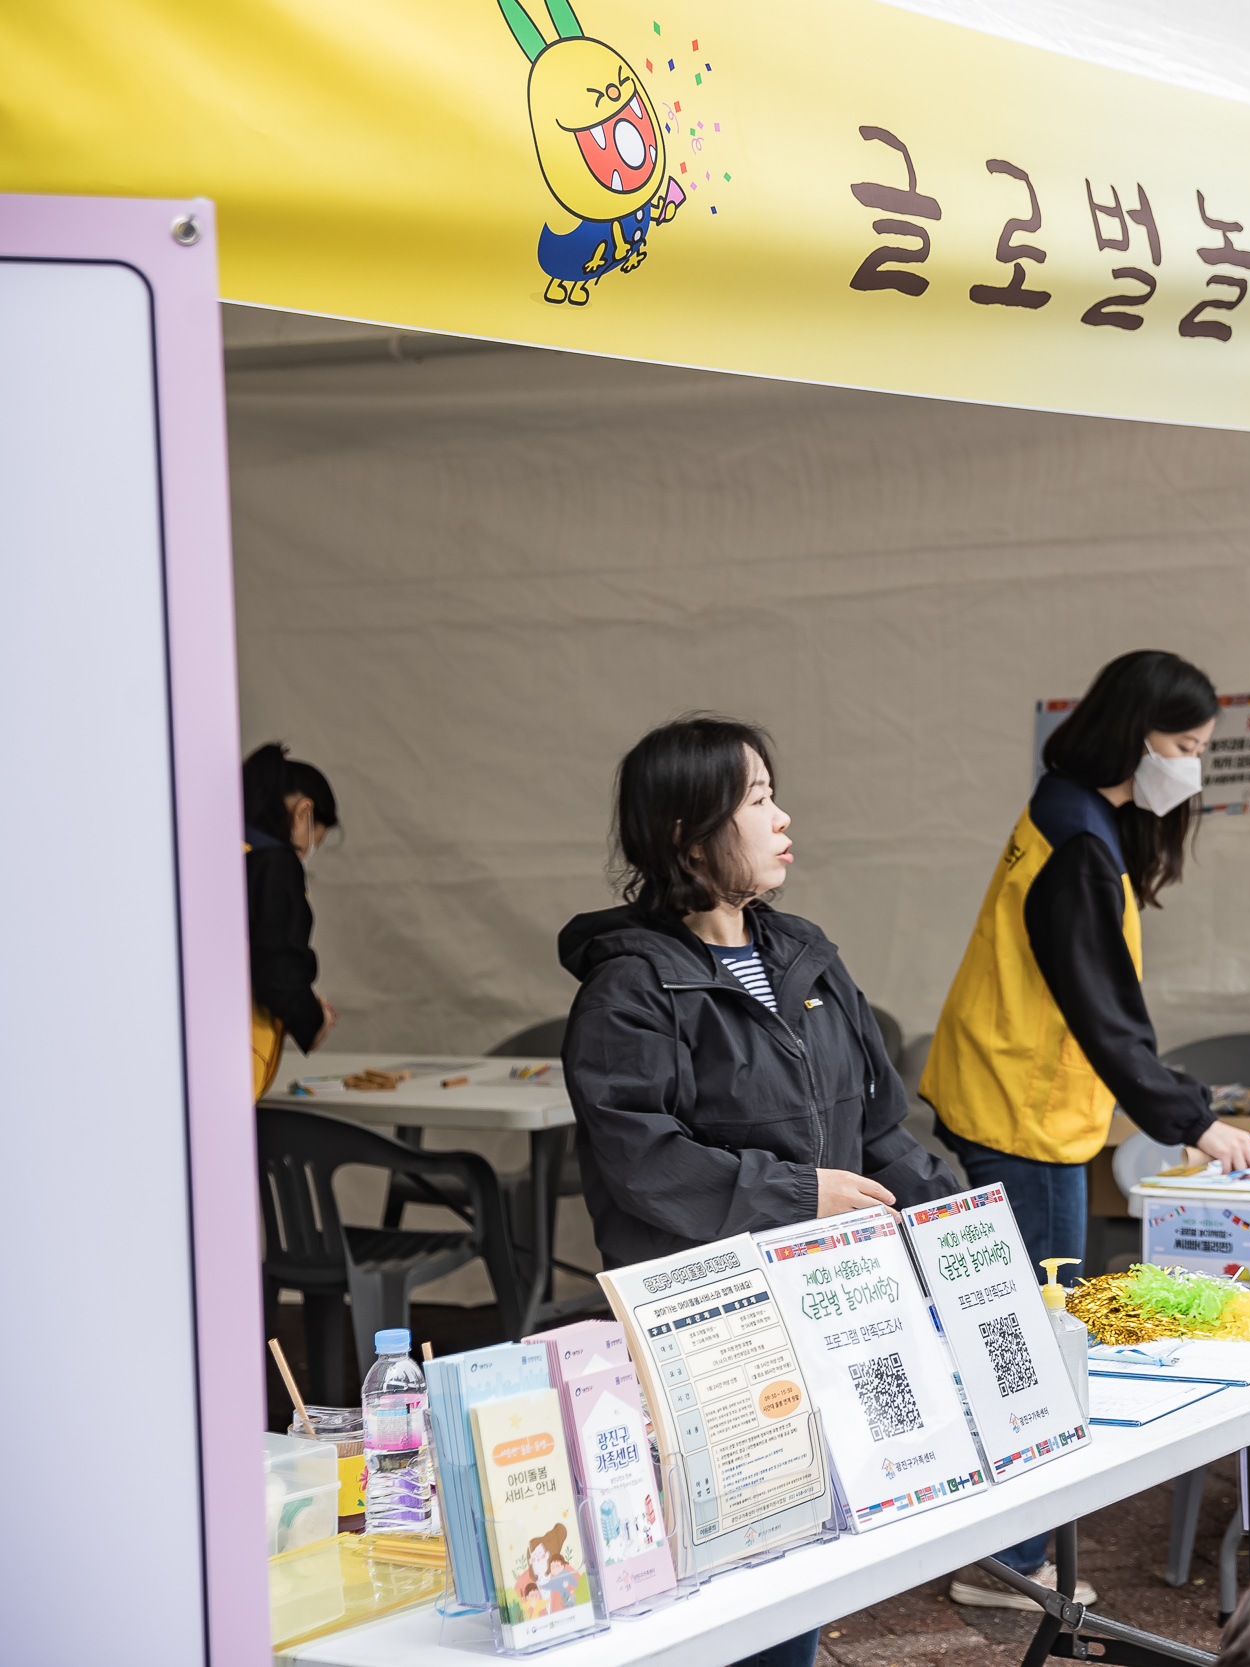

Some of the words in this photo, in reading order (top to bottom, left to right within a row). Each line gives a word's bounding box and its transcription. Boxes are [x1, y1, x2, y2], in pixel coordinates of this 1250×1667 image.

[643, 1273, 672, 1293] 광진구
[671, 1262, 707, 1284] 아이돌봄
[704, 1252, 740, 1273] 지원사업
[654, 1304, 678, 1318] 찾아가는
[679, 1293, 721, 1310] 아이돌봄서비스와
[721, 1286, 733, 1296] 함께
[735, 1280, 753, 1292] 하세요!
[958, 1290, 986, 1310] 프로그램
[984, 1279, 1017, 1303] 만족도조사
[824, 1328, 860, 1351] 프로그램
[860, 1317, 903, 1342] 만족도조사
[762, 1403, 775, 1413] 시간대
[775, 1400, 784, 1409] 돌봄
[1020, 1406, 1049, 1426] 광진구가족센터
[597, 1426, 628, 1451] 광진구
[596, 1443, 638, 1470] 가족센터
[894, 1451, 936, 1472] 광진구가족센터
[507, 1466, 548, 1487] 아이돌봄
[505, 1485, 534, 1503] 서비스
[536, 1478, 557, 1496] 안내
[700, 1524, 717, 1535] 이용문의
